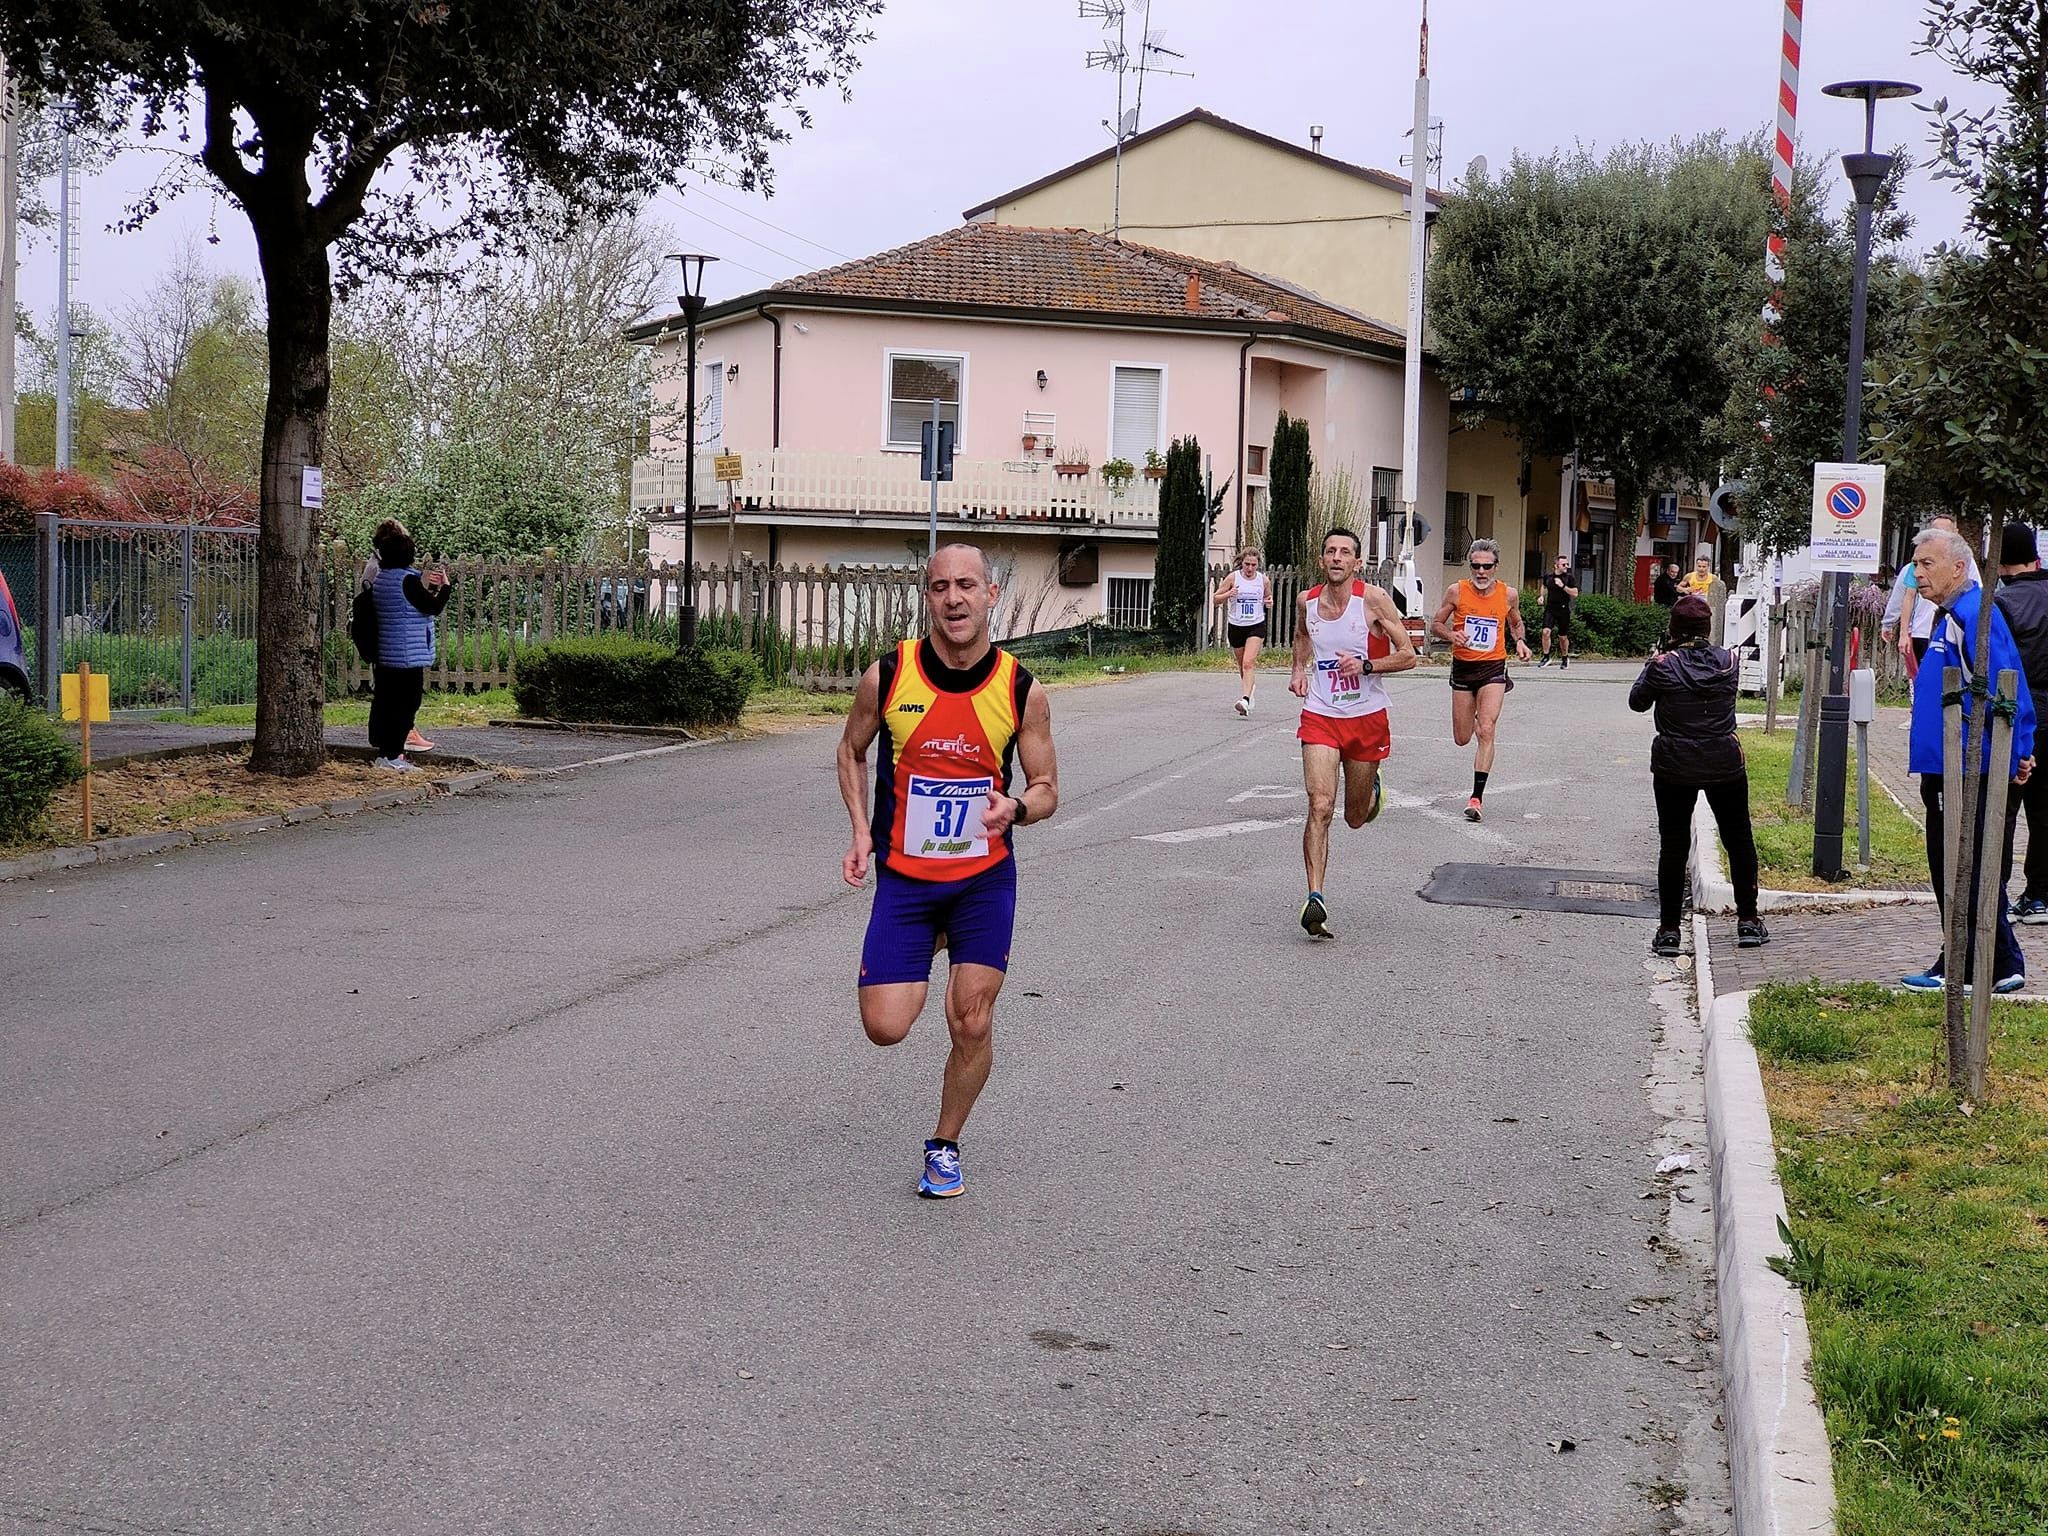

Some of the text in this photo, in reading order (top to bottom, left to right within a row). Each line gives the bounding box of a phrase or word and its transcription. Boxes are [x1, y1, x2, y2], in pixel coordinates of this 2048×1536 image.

[1241, 604, 1254, 614] 106
[1473, 626, 1489, 642] 26
[899, 703, 926, 713] AVIS
[934, 799, 969, 837] 37
